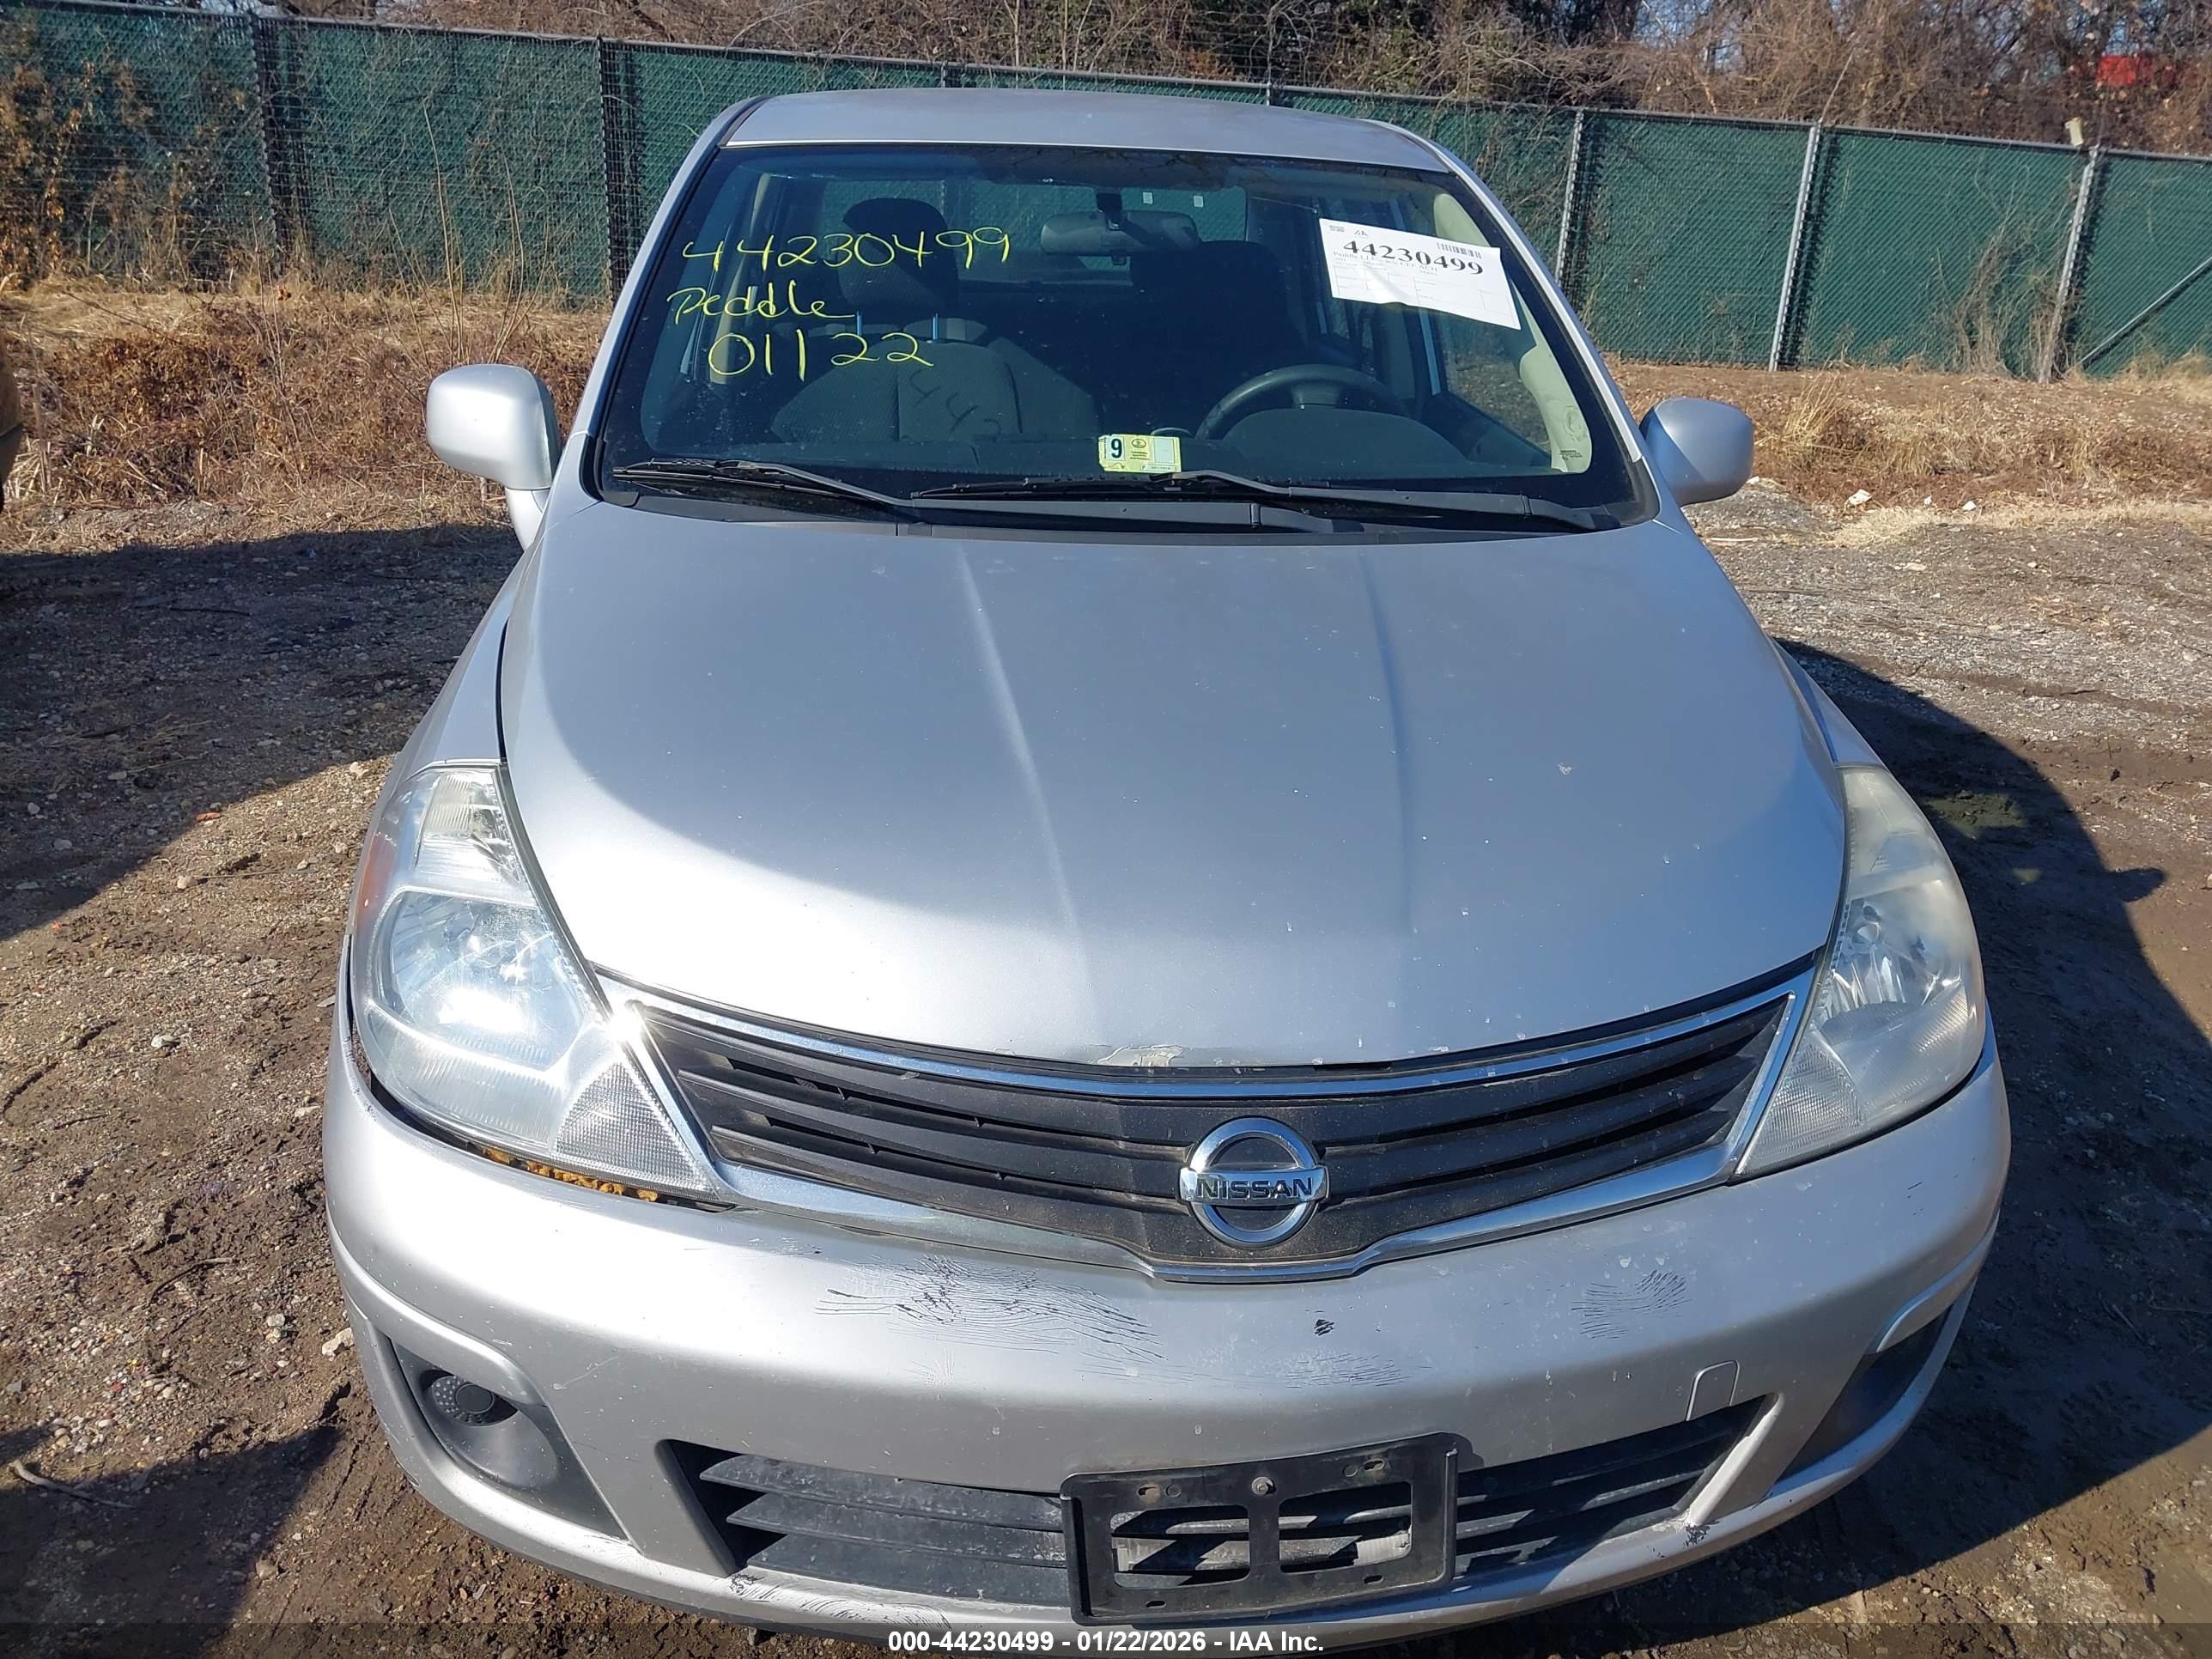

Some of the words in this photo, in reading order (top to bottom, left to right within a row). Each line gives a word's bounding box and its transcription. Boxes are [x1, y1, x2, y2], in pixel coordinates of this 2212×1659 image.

[683, 226, 1010, 271] 44230499
[1343, 240, 1484, 276] 44230499
[666, 279, 855, 325] Peddle
[1110, 438, 1122, 459] 9
[1196, 1176, 1313, 1200] NISSAN
